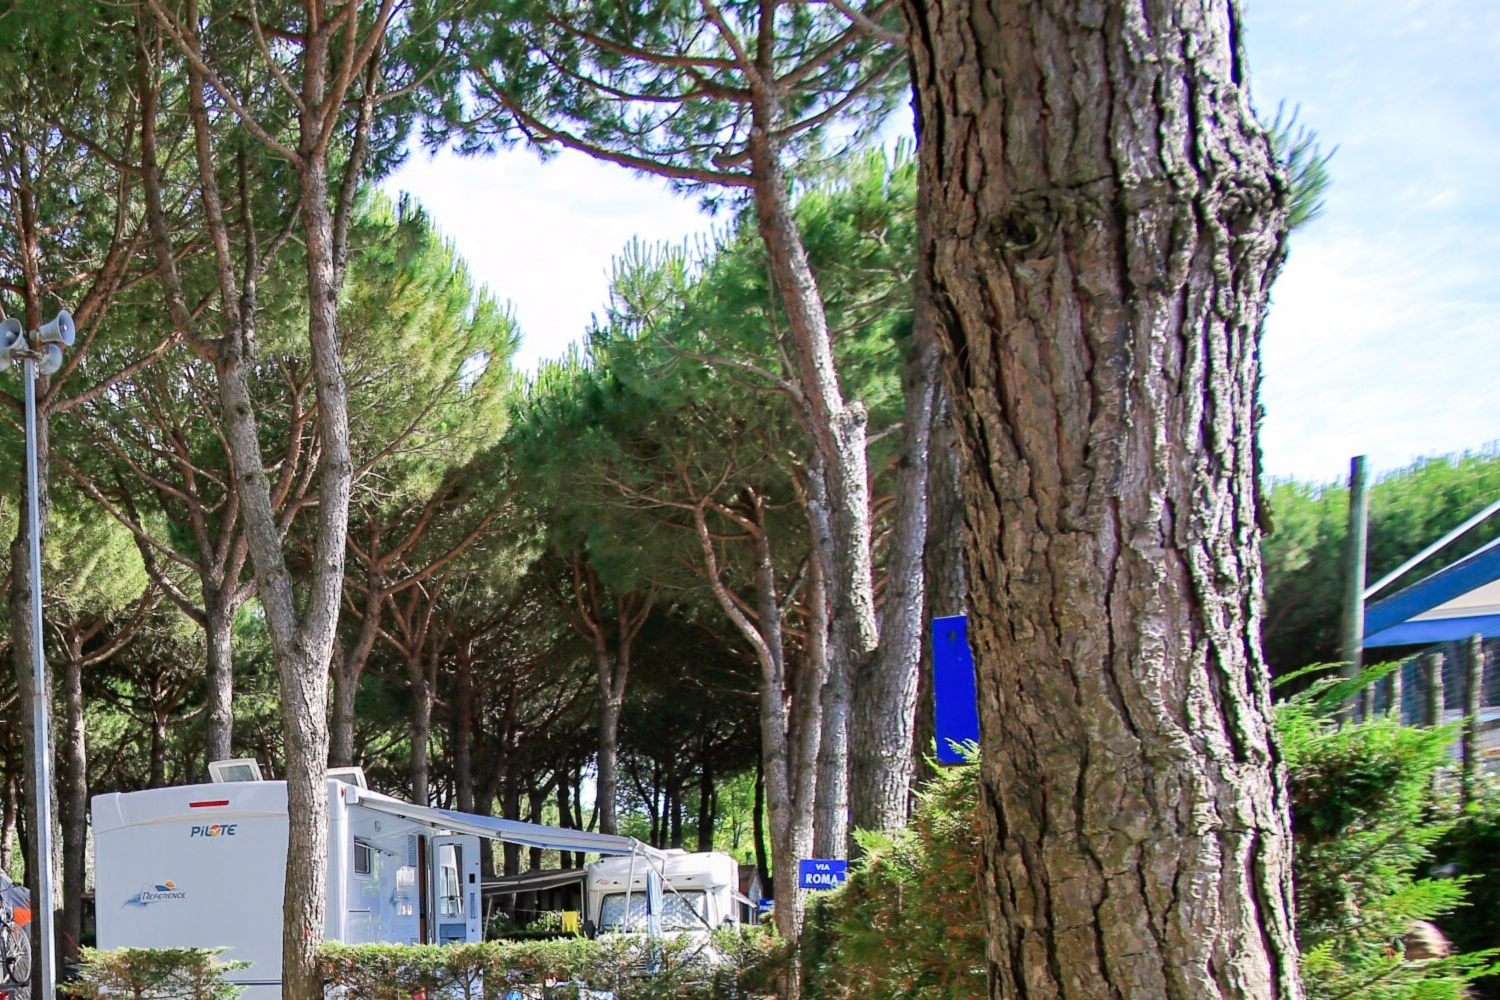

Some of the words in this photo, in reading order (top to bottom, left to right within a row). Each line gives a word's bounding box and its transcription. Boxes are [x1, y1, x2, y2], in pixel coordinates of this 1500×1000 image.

[815, 863, 831, 871] VIA
[805, 873, 839, 884] ROMA
[142, 891, 187, 901] REFERENCE
